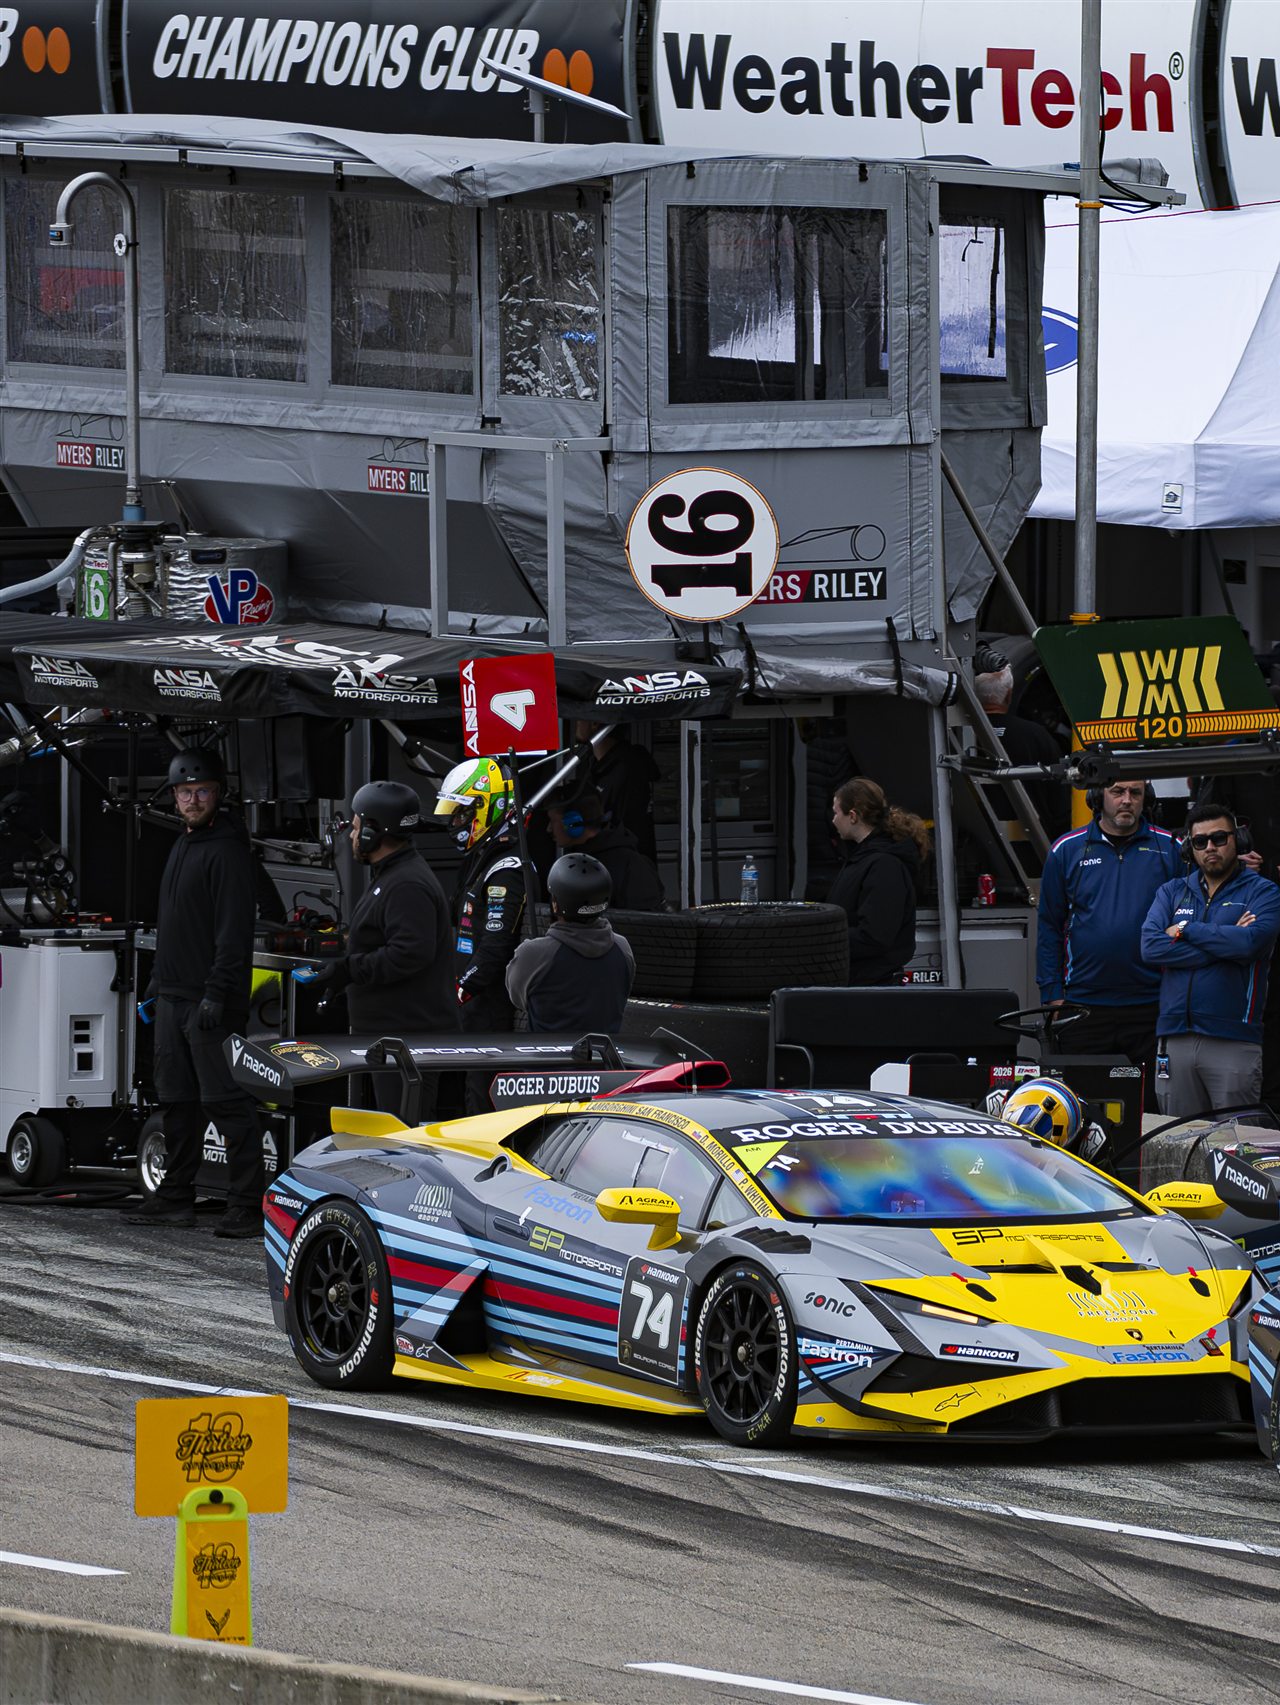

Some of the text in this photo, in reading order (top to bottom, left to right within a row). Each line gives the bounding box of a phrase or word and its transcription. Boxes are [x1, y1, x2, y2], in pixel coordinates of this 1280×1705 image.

[153, 14, 540, 93] CHAMPIONS CLUB
[57, 444, 124, 468] MYERS RILEY
[369, 468, 406, 491] MYERS
[647, 489, 755, 598] 16
[207, 568, 258, 624] VP
[813, 571, 884, 598] RILEY
[241, 599, 274, 622] Racing
[30, 655, 93, 677] ANSA
[34, 674, 98, 688] MOTORSPORTS
[153, 668, 219, 690] ANSA
[332, 671, 438, 691] ANSA
[597, 670, 708, 693] ANSA
[159, 688, 222, 702] MOTORSPORTS
[334, 689, 438, 704] MOTORSPORTS
[595, 688, 711, 705] MOTORSPORTS
[462, 660, 480, 755] ANSA
[489, 689, 536, 732] 4
[1139, 716, 1183, 740] 120
[912, 971, 942, 983] RILEY
[242, 1053, 282, 1087] macron
[992, 1066, 1013, 1077] 2026
[496, 1075, 601, 1096] ROGER DUBUIS
[586, 1101, 690, 1130] LAMBORGHINI SAN FRANCISCO
[731, 1120, 1024, 1143] ROGER DUBUIS
[705, 1140, 734, 1171] MORILLO
[767, 1154, 801, 1172] 74
[1225, 1166, 1266, 1200] macron
[524, 1185, 593, 1225] Fastron
[636, 1197, 675, 1206] AGRATI
[744, 1185, 773, 1218] WHITING
[1164, 1192, 1202, 1200] AGRATI
[951, 1228, 1004, 1246] SP
[529, 1225, 623, 1276] SP MOTORSPORTS
[630, 1280, 674, 1349] 74
[1078, 1309, 1157, 1317] FREESTONE
[801, 1338, 873, 1368] Fastron
[836, 1338, 874, 1353] PERTAMINA
[1112, 1350, 1191, 1363] Fastron
